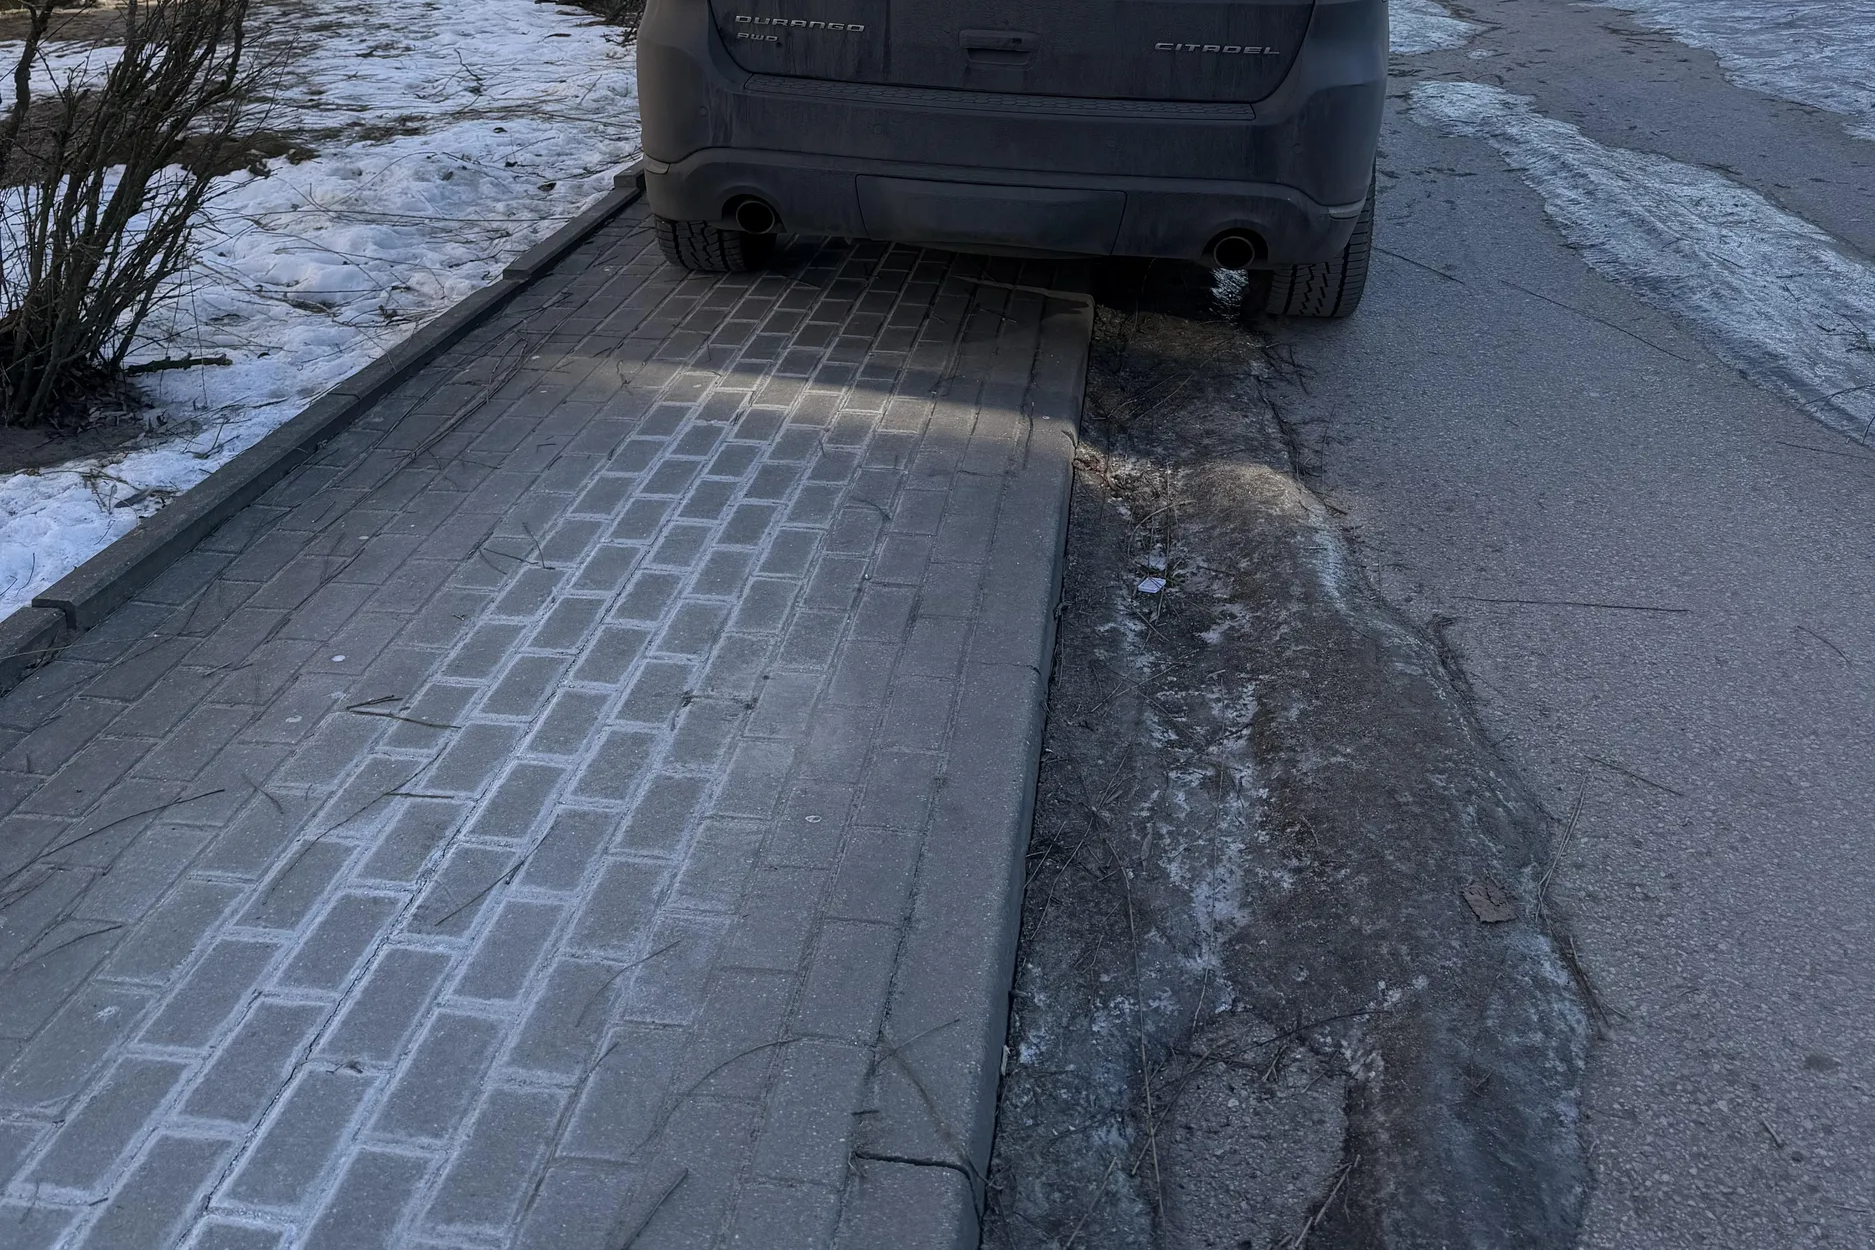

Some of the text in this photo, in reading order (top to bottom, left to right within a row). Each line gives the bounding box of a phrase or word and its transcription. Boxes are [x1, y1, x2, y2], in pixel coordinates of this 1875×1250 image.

[735, 15, 865, 32] DURANGO
[736, 32, 779, 42] AWD
[1154, 42, 1281, 55] CITADEL
